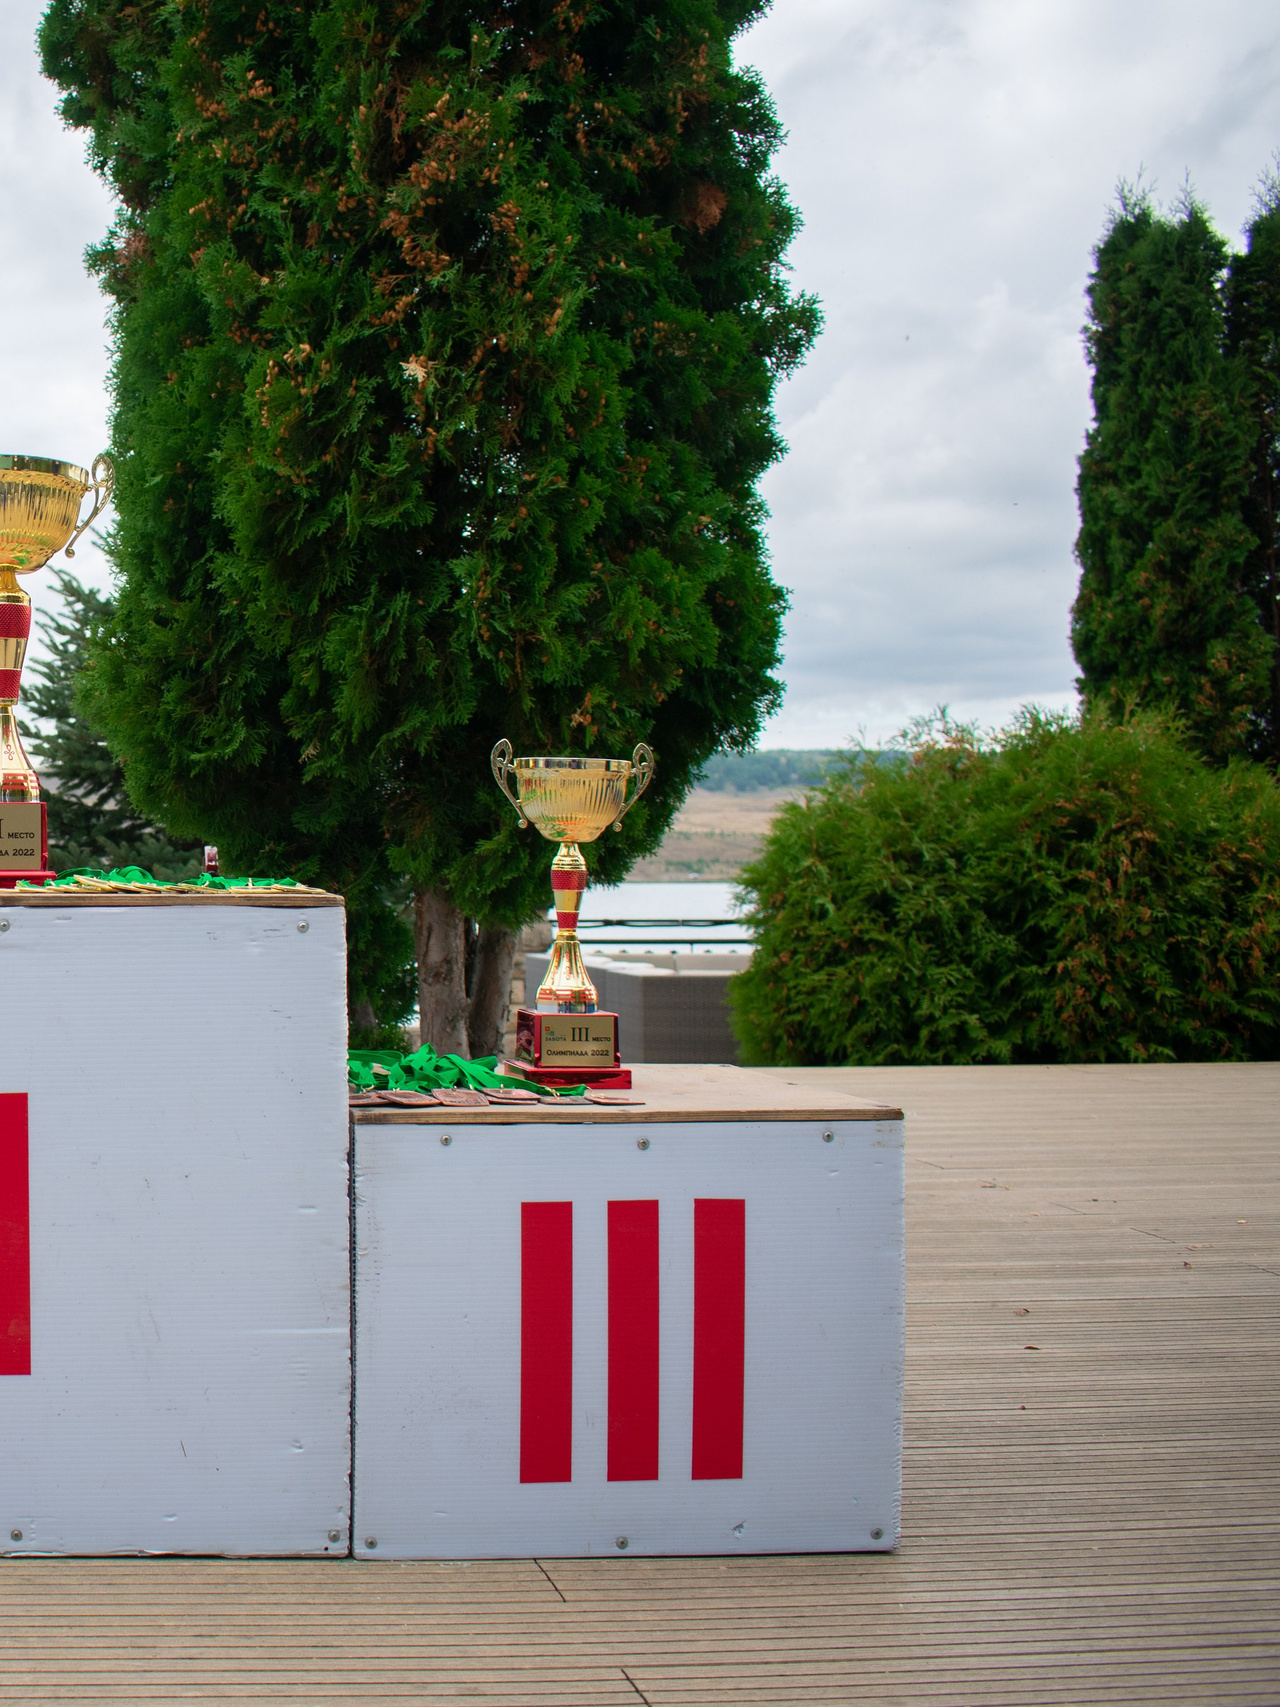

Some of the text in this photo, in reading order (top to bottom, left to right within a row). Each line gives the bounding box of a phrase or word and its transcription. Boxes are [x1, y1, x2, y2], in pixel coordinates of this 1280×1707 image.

[12, 848, 35, 857] 2022
[571, 1027, 590, 1042] III
[590, 1049, 610, 1057] 2022
[520, 1198, 746, 1484] III
